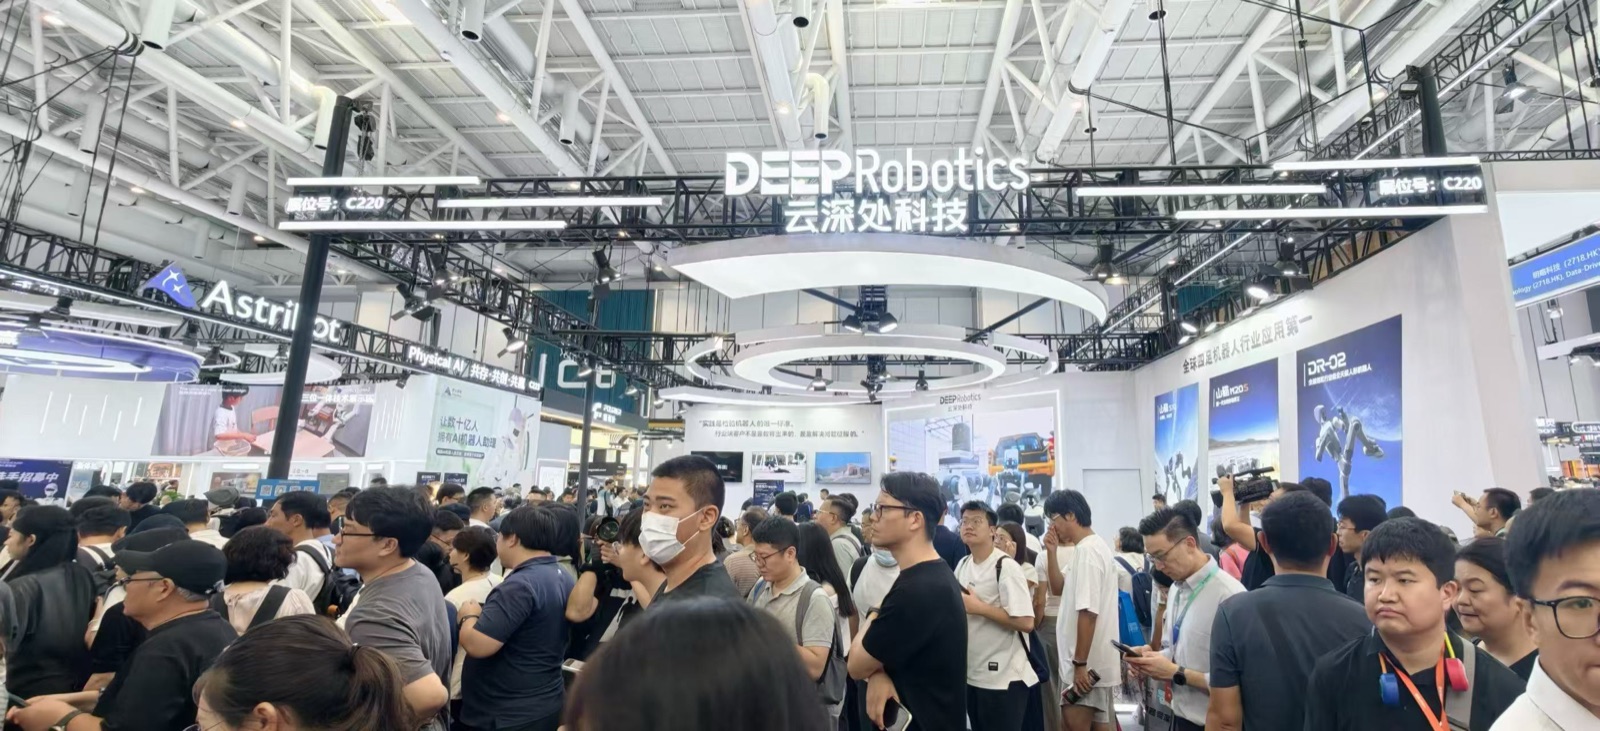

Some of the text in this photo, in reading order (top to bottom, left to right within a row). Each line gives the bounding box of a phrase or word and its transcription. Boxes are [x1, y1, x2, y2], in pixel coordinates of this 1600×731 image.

[1443, 176, 1482, 190] C220
[345, 197, 385, 211] C220
[784, 198, 968, 233] 云深处科技
[201, 279, 342, 342] Astriot
[1182, 314, 1313, 375] 全球四足机器人行业应用第一
[408, 345, 451, 369] Physical
[452, 358, 464, 373] AI
[1307, 351, 1347, 376] DR-02
[440, 416, 479, 433] 让数十亿人
